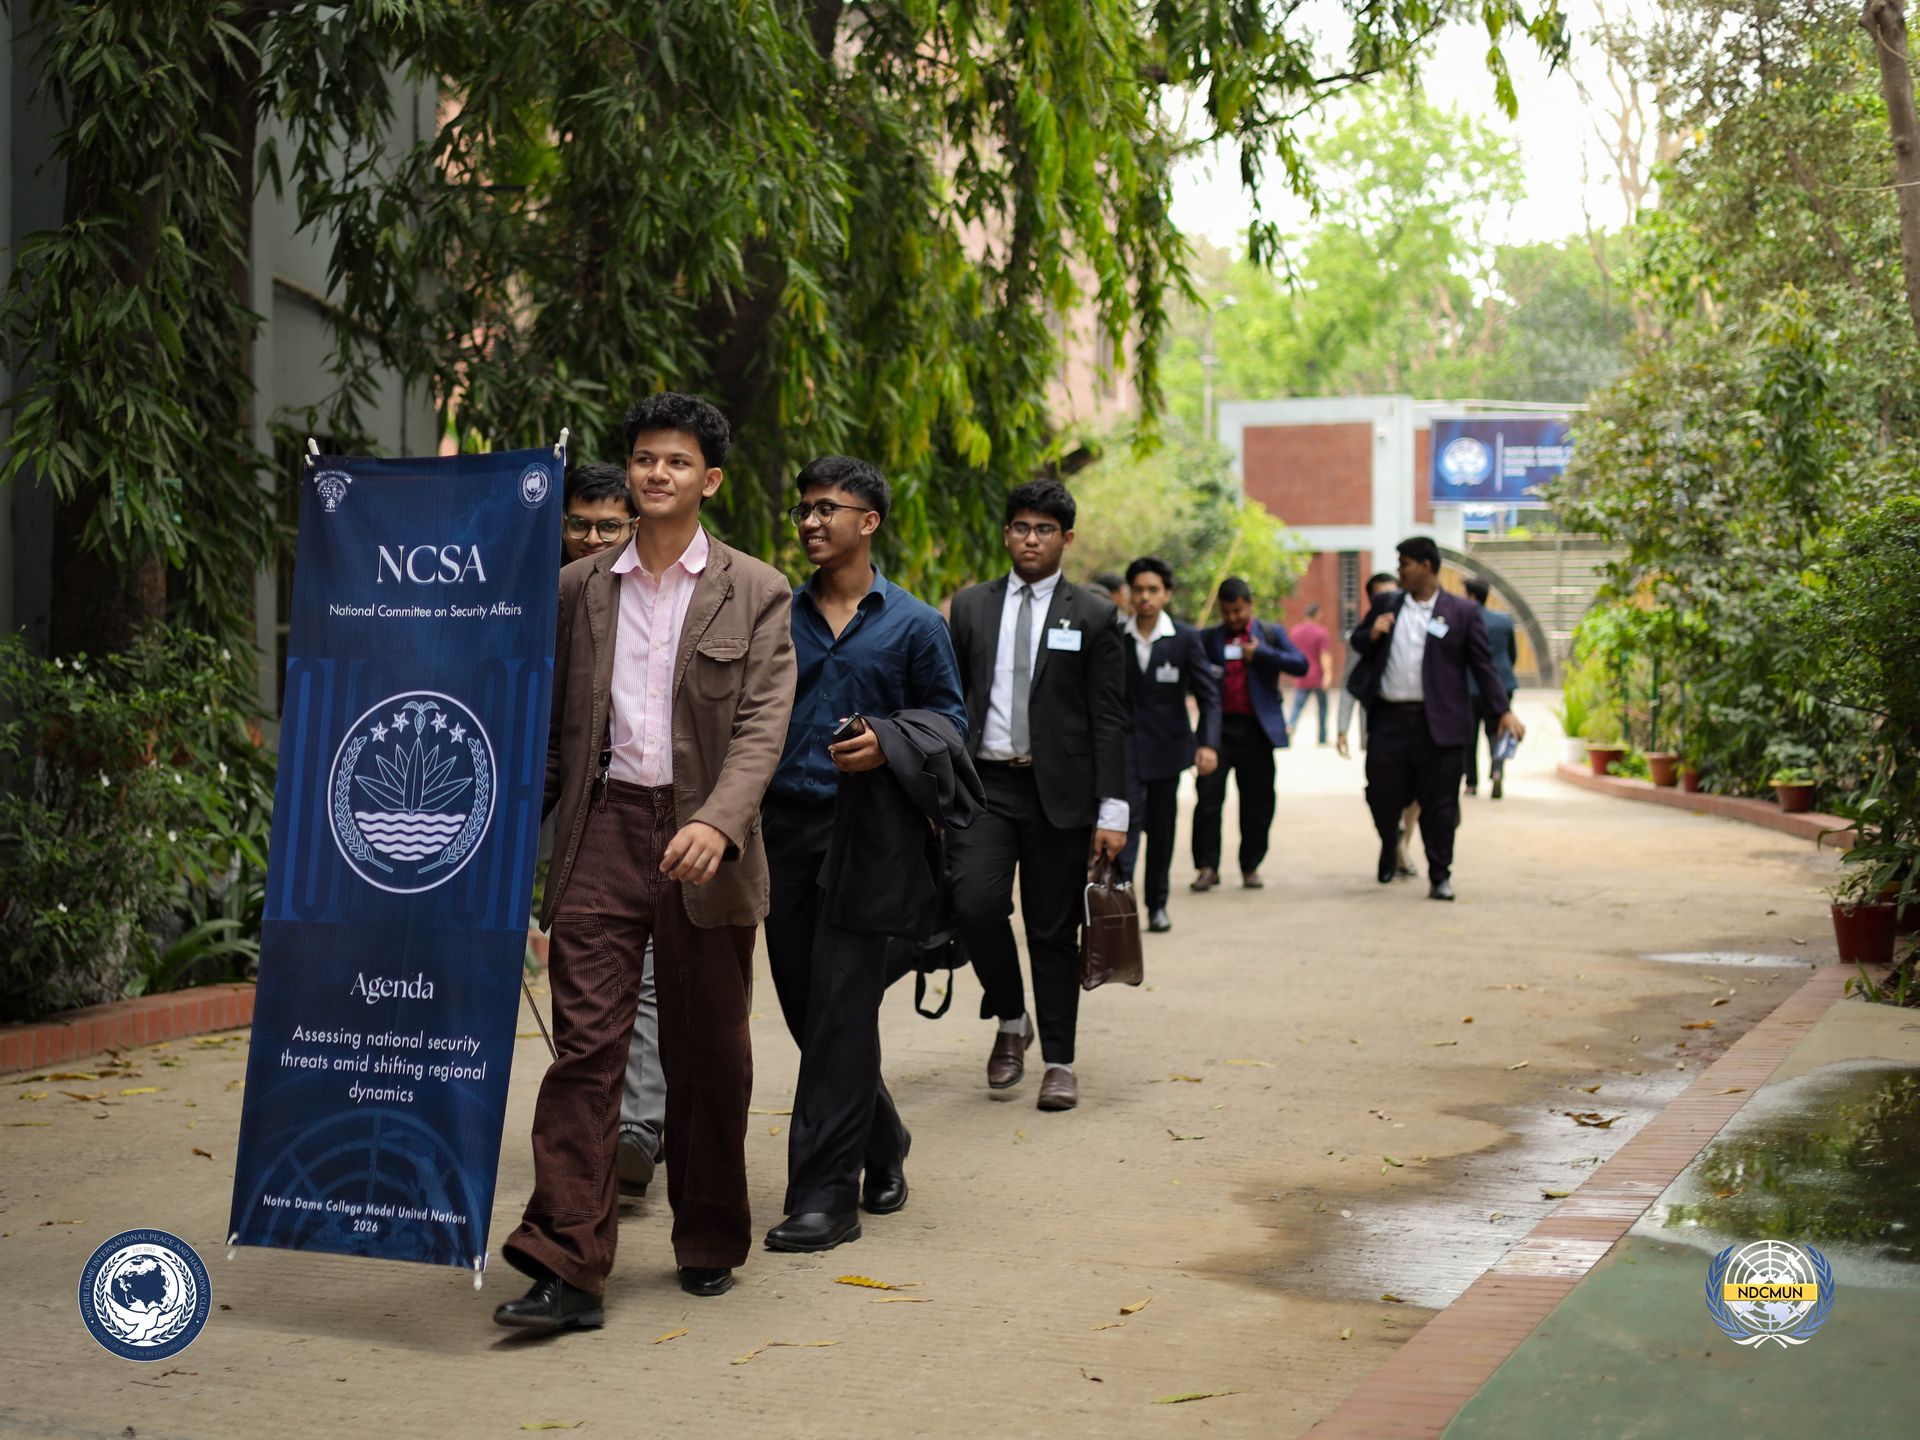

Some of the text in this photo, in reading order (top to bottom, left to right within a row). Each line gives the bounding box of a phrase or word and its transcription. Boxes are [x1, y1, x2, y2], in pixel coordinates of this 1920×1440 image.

[376, 544, 486, 584] NCSA
[329, 602, 522, 619] National Committee on Security Affairs
[350, 972, 434, 1004] Agenda
[292, 1025, 480, 1057] Assessing national security
[280, 1049, 486, 1082] threats amid shifting regional
[349, 1081, 414, 1103] dynamics
[263, 1194, 467, 1225] Notre Dame College Model United Nations
[353, 1219, 378, 1232] 2026
